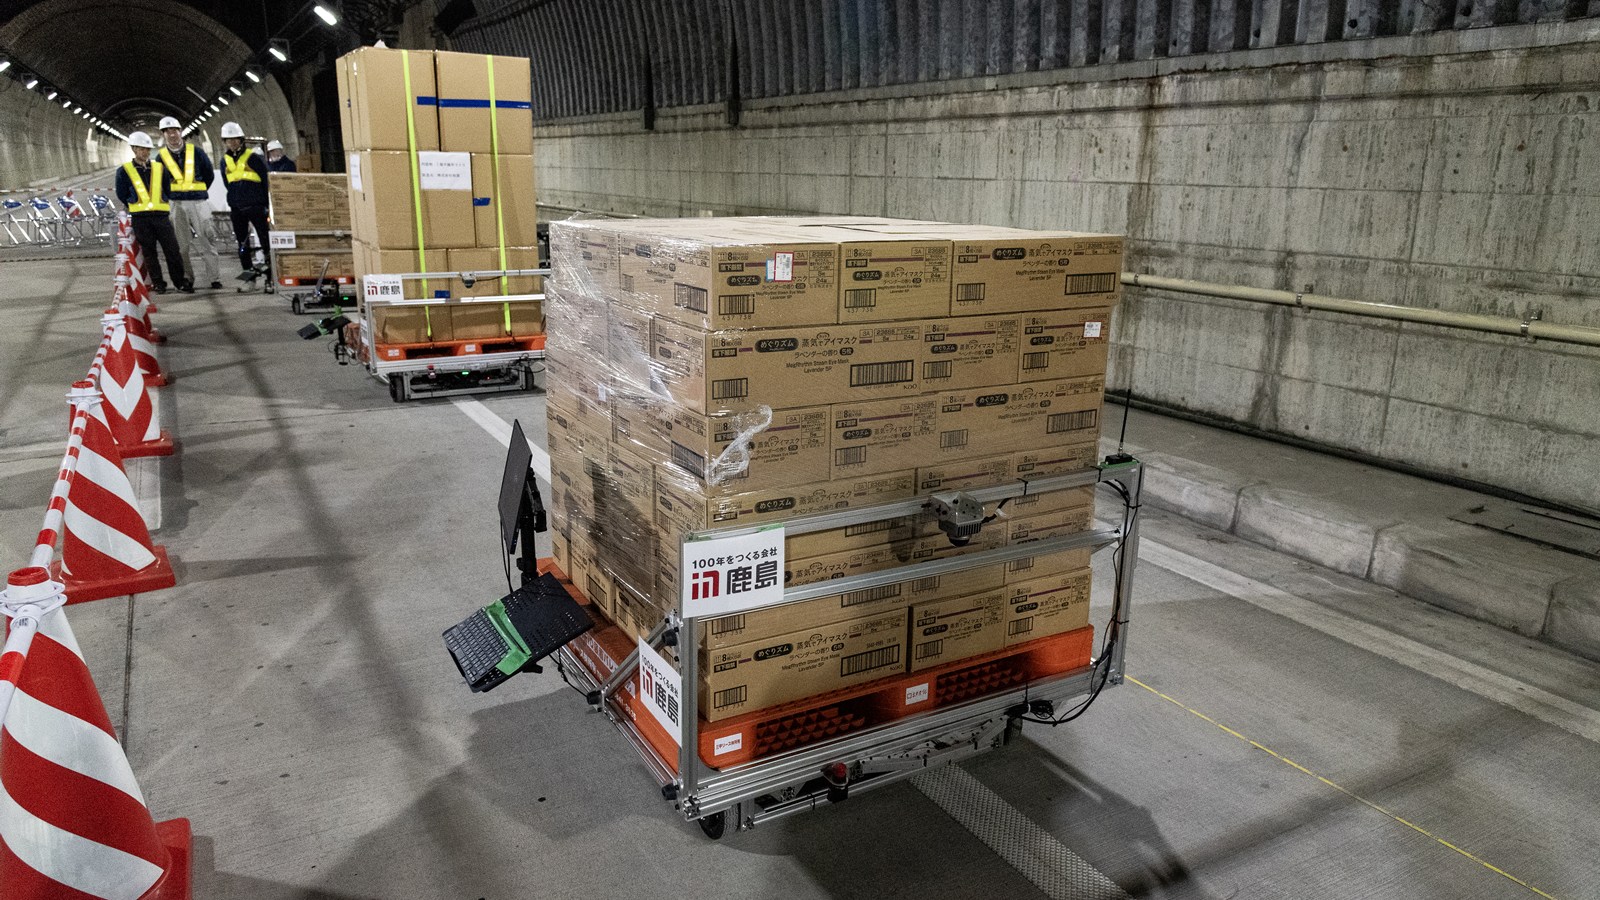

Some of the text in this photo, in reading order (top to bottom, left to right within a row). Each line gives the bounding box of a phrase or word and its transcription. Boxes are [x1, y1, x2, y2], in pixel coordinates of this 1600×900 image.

[760, 340, 794, 350] めぐりズム
[692, 546, 778, 569] 100年をつくる会社
[726, 560, 778, 595] 鹿島
[642, 654, 679, 698] 100年をつくる会社
[654, 681, 679, 728] 鹿島
